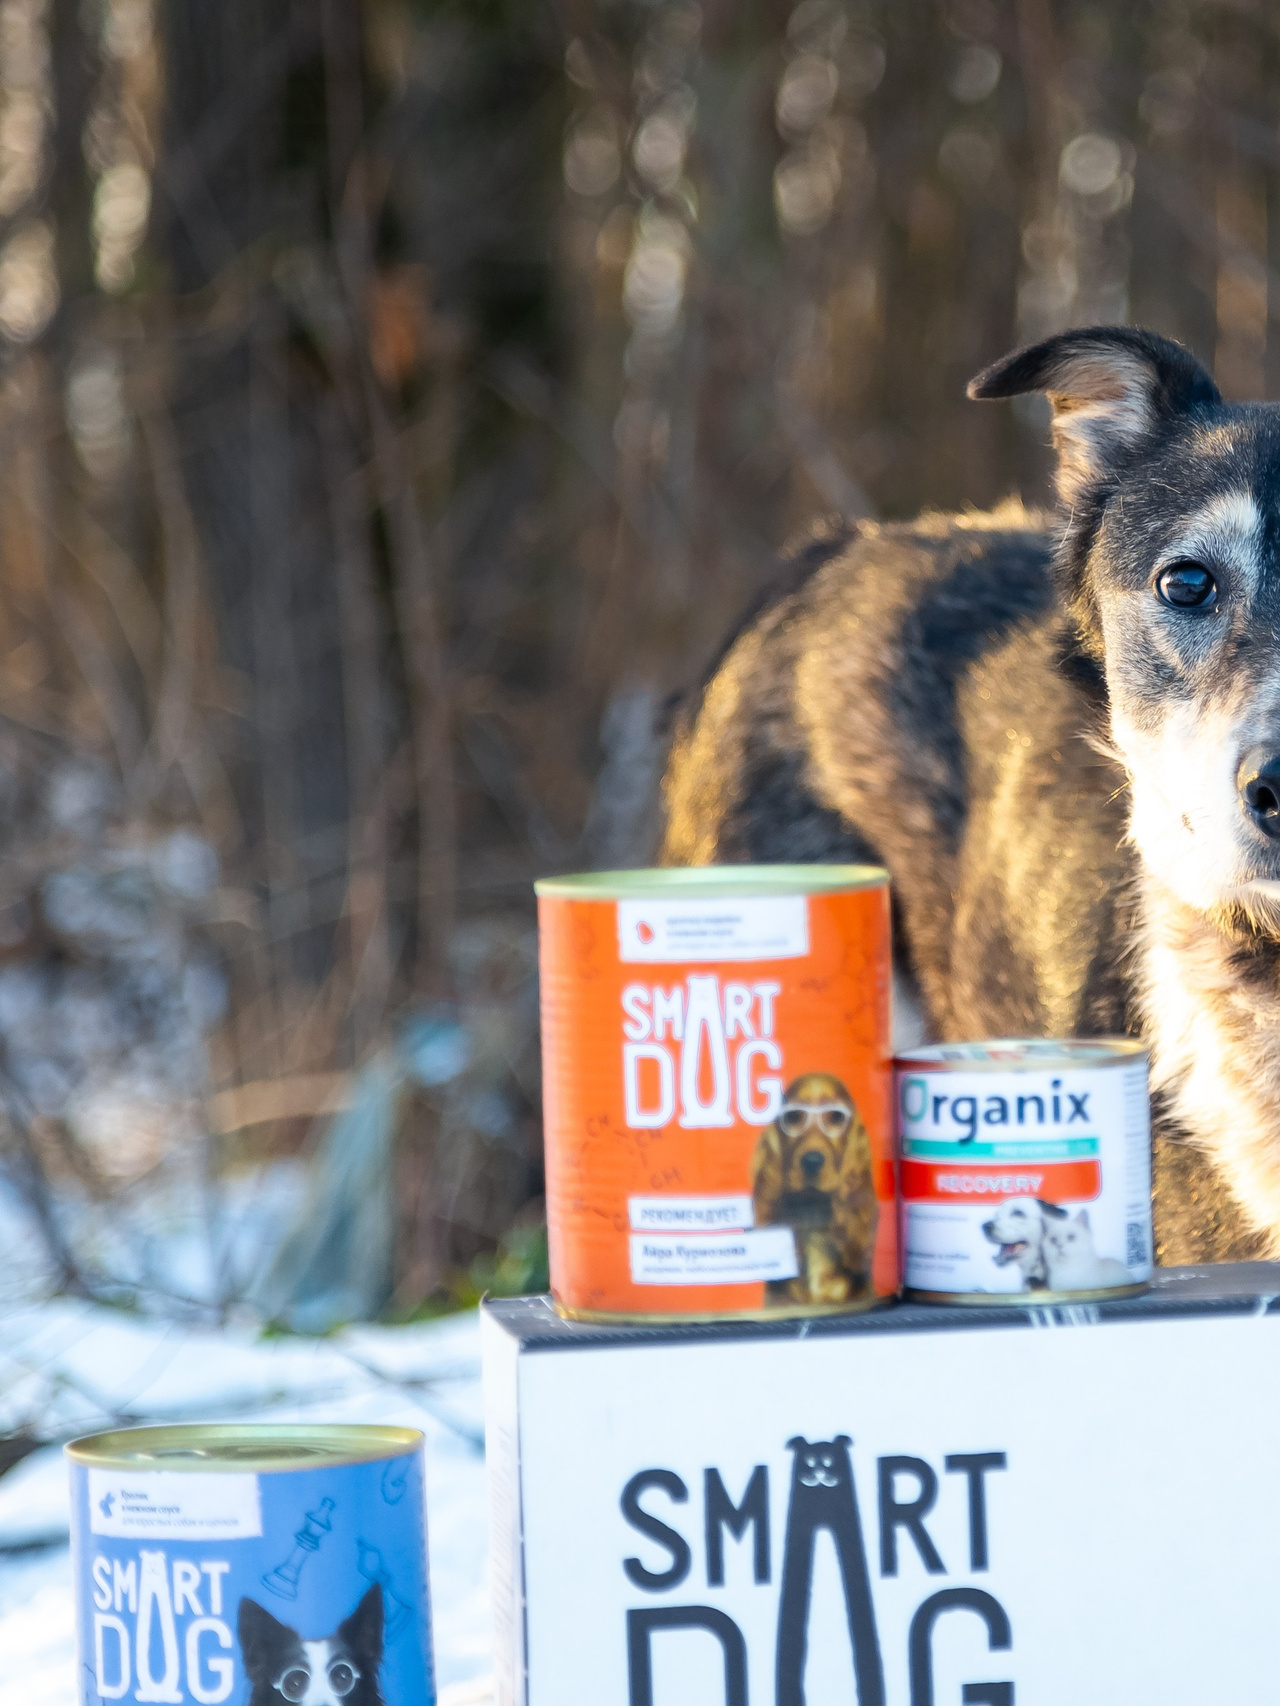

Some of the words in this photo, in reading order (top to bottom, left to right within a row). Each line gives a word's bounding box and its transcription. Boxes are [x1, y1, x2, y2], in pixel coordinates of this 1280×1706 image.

[622, 976, 780, 1040] SMART
[624, 1039, 783, 1128] DOG
[902, 1077, 1091, 1146] Organix
[936, 1174, 1043, 1193] RECOVERY
[619, 1434, 1007, 1593] SMART
[92, 1551, 230, 1616] SMART
[94, 1613, 234, 1704] DOG
